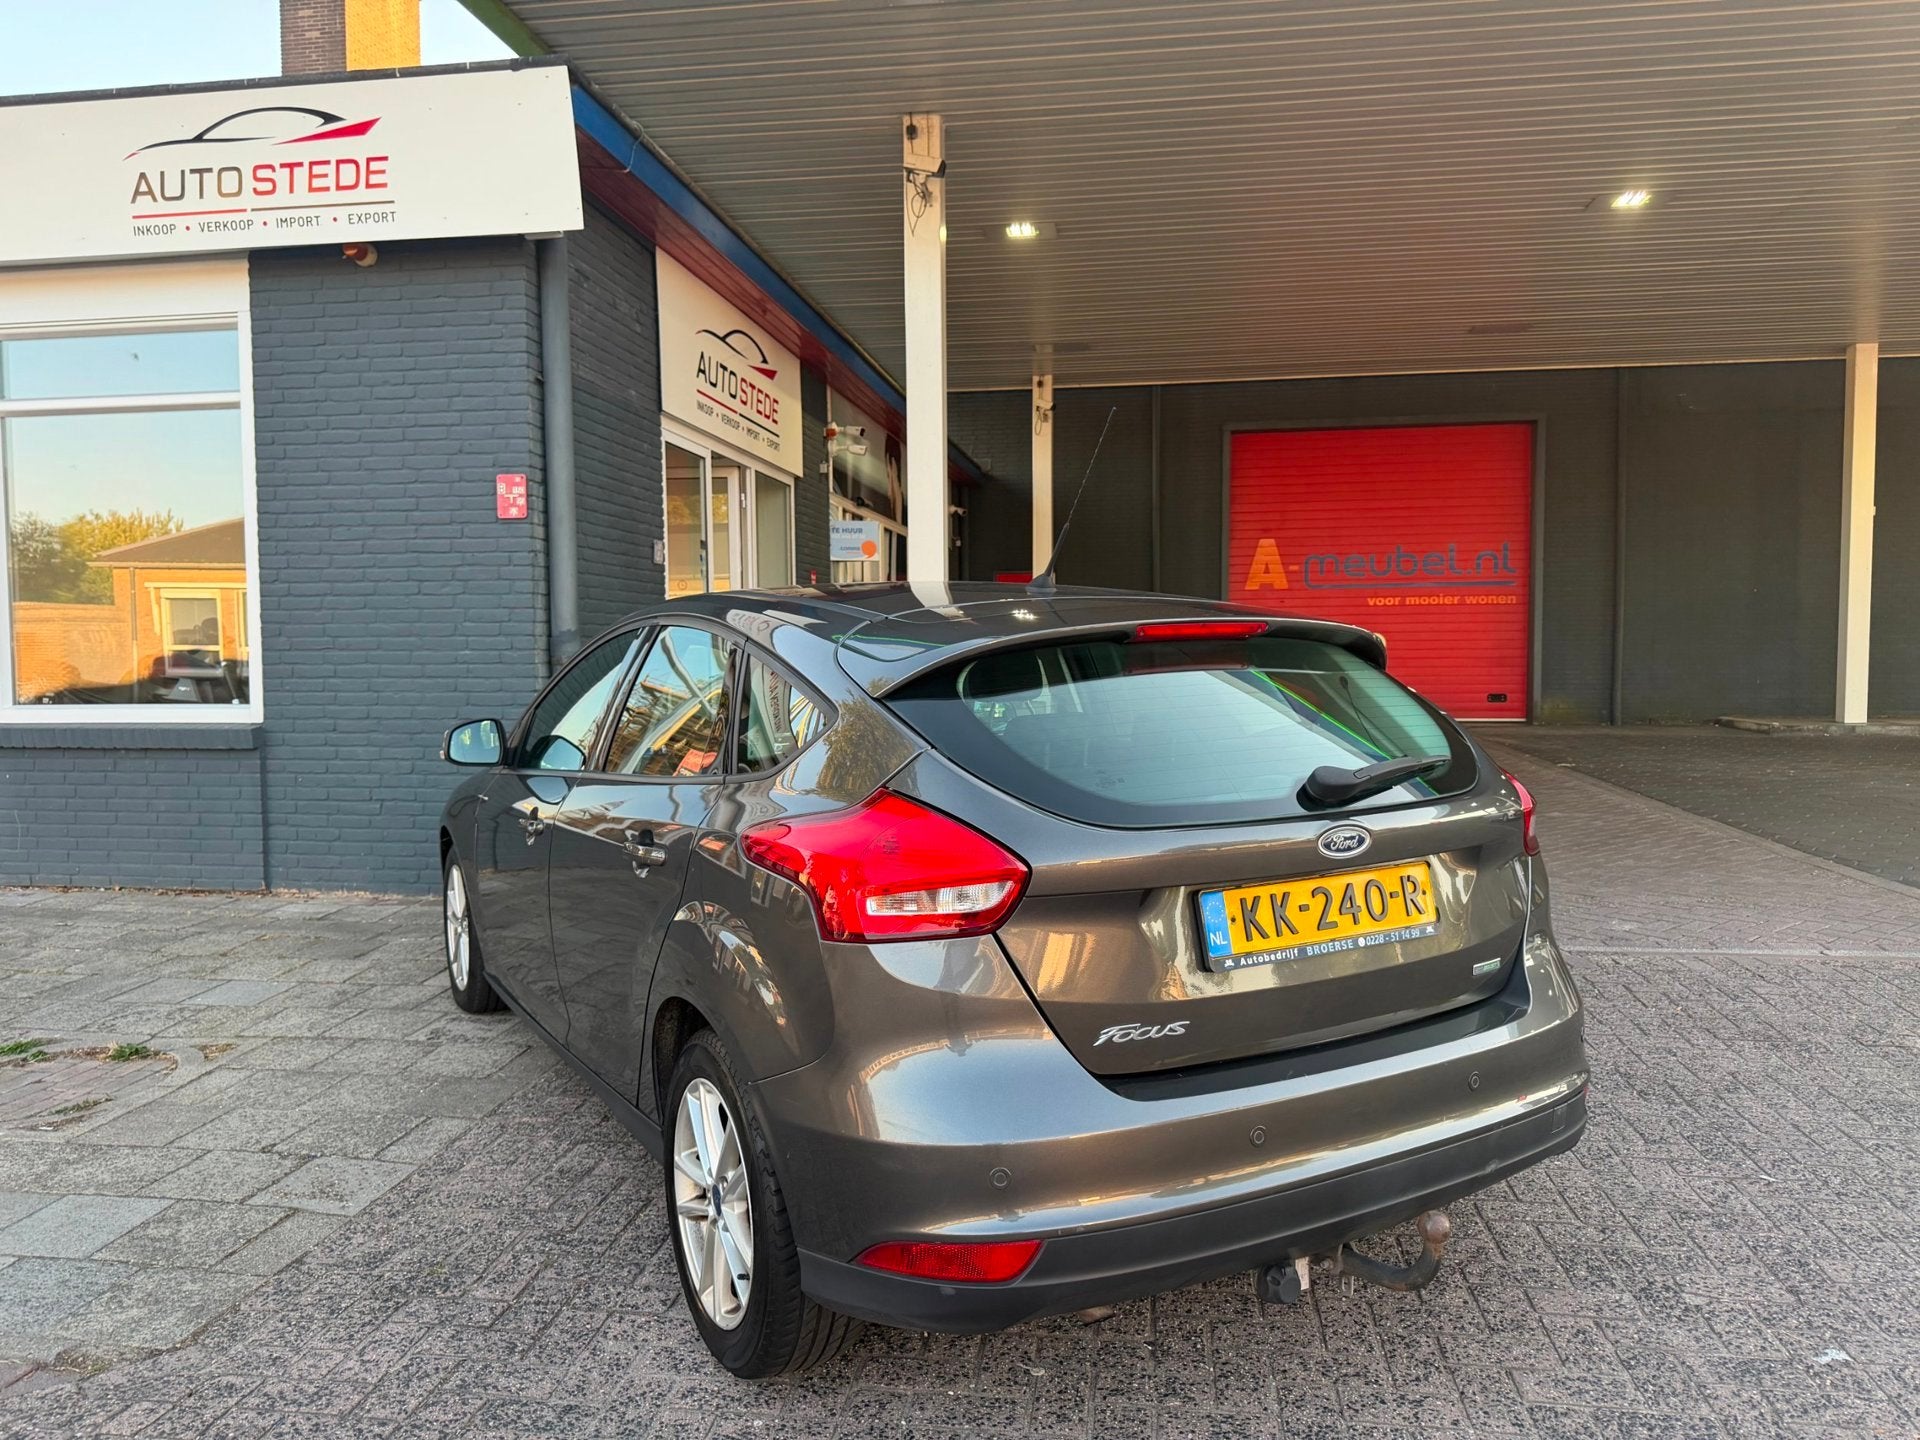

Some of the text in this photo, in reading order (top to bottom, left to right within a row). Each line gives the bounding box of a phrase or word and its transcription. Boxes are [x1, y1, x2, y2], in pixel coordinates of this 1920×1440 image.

[133, 211, 397, 236] INKOOP VERKOOP IMPORT EXPORT
[1367, 593, 1517, 606] voor mooier wonen
[1326, 832, 1359, 850] Ford
[1240, 874, 1426, 942] KK-240-R
[1209, 931, 1228, 947] NL
[1240, 947, 1299, 967] Autobedrijf
[1306, 939, 1354, 956] BROERSE
[1366, 935, 1385, 946] 0228
[1391, 932, 1399, 942] 51
[1401, 930, 1410, 940] 14
[1410, 928, 1420, 938] 99
